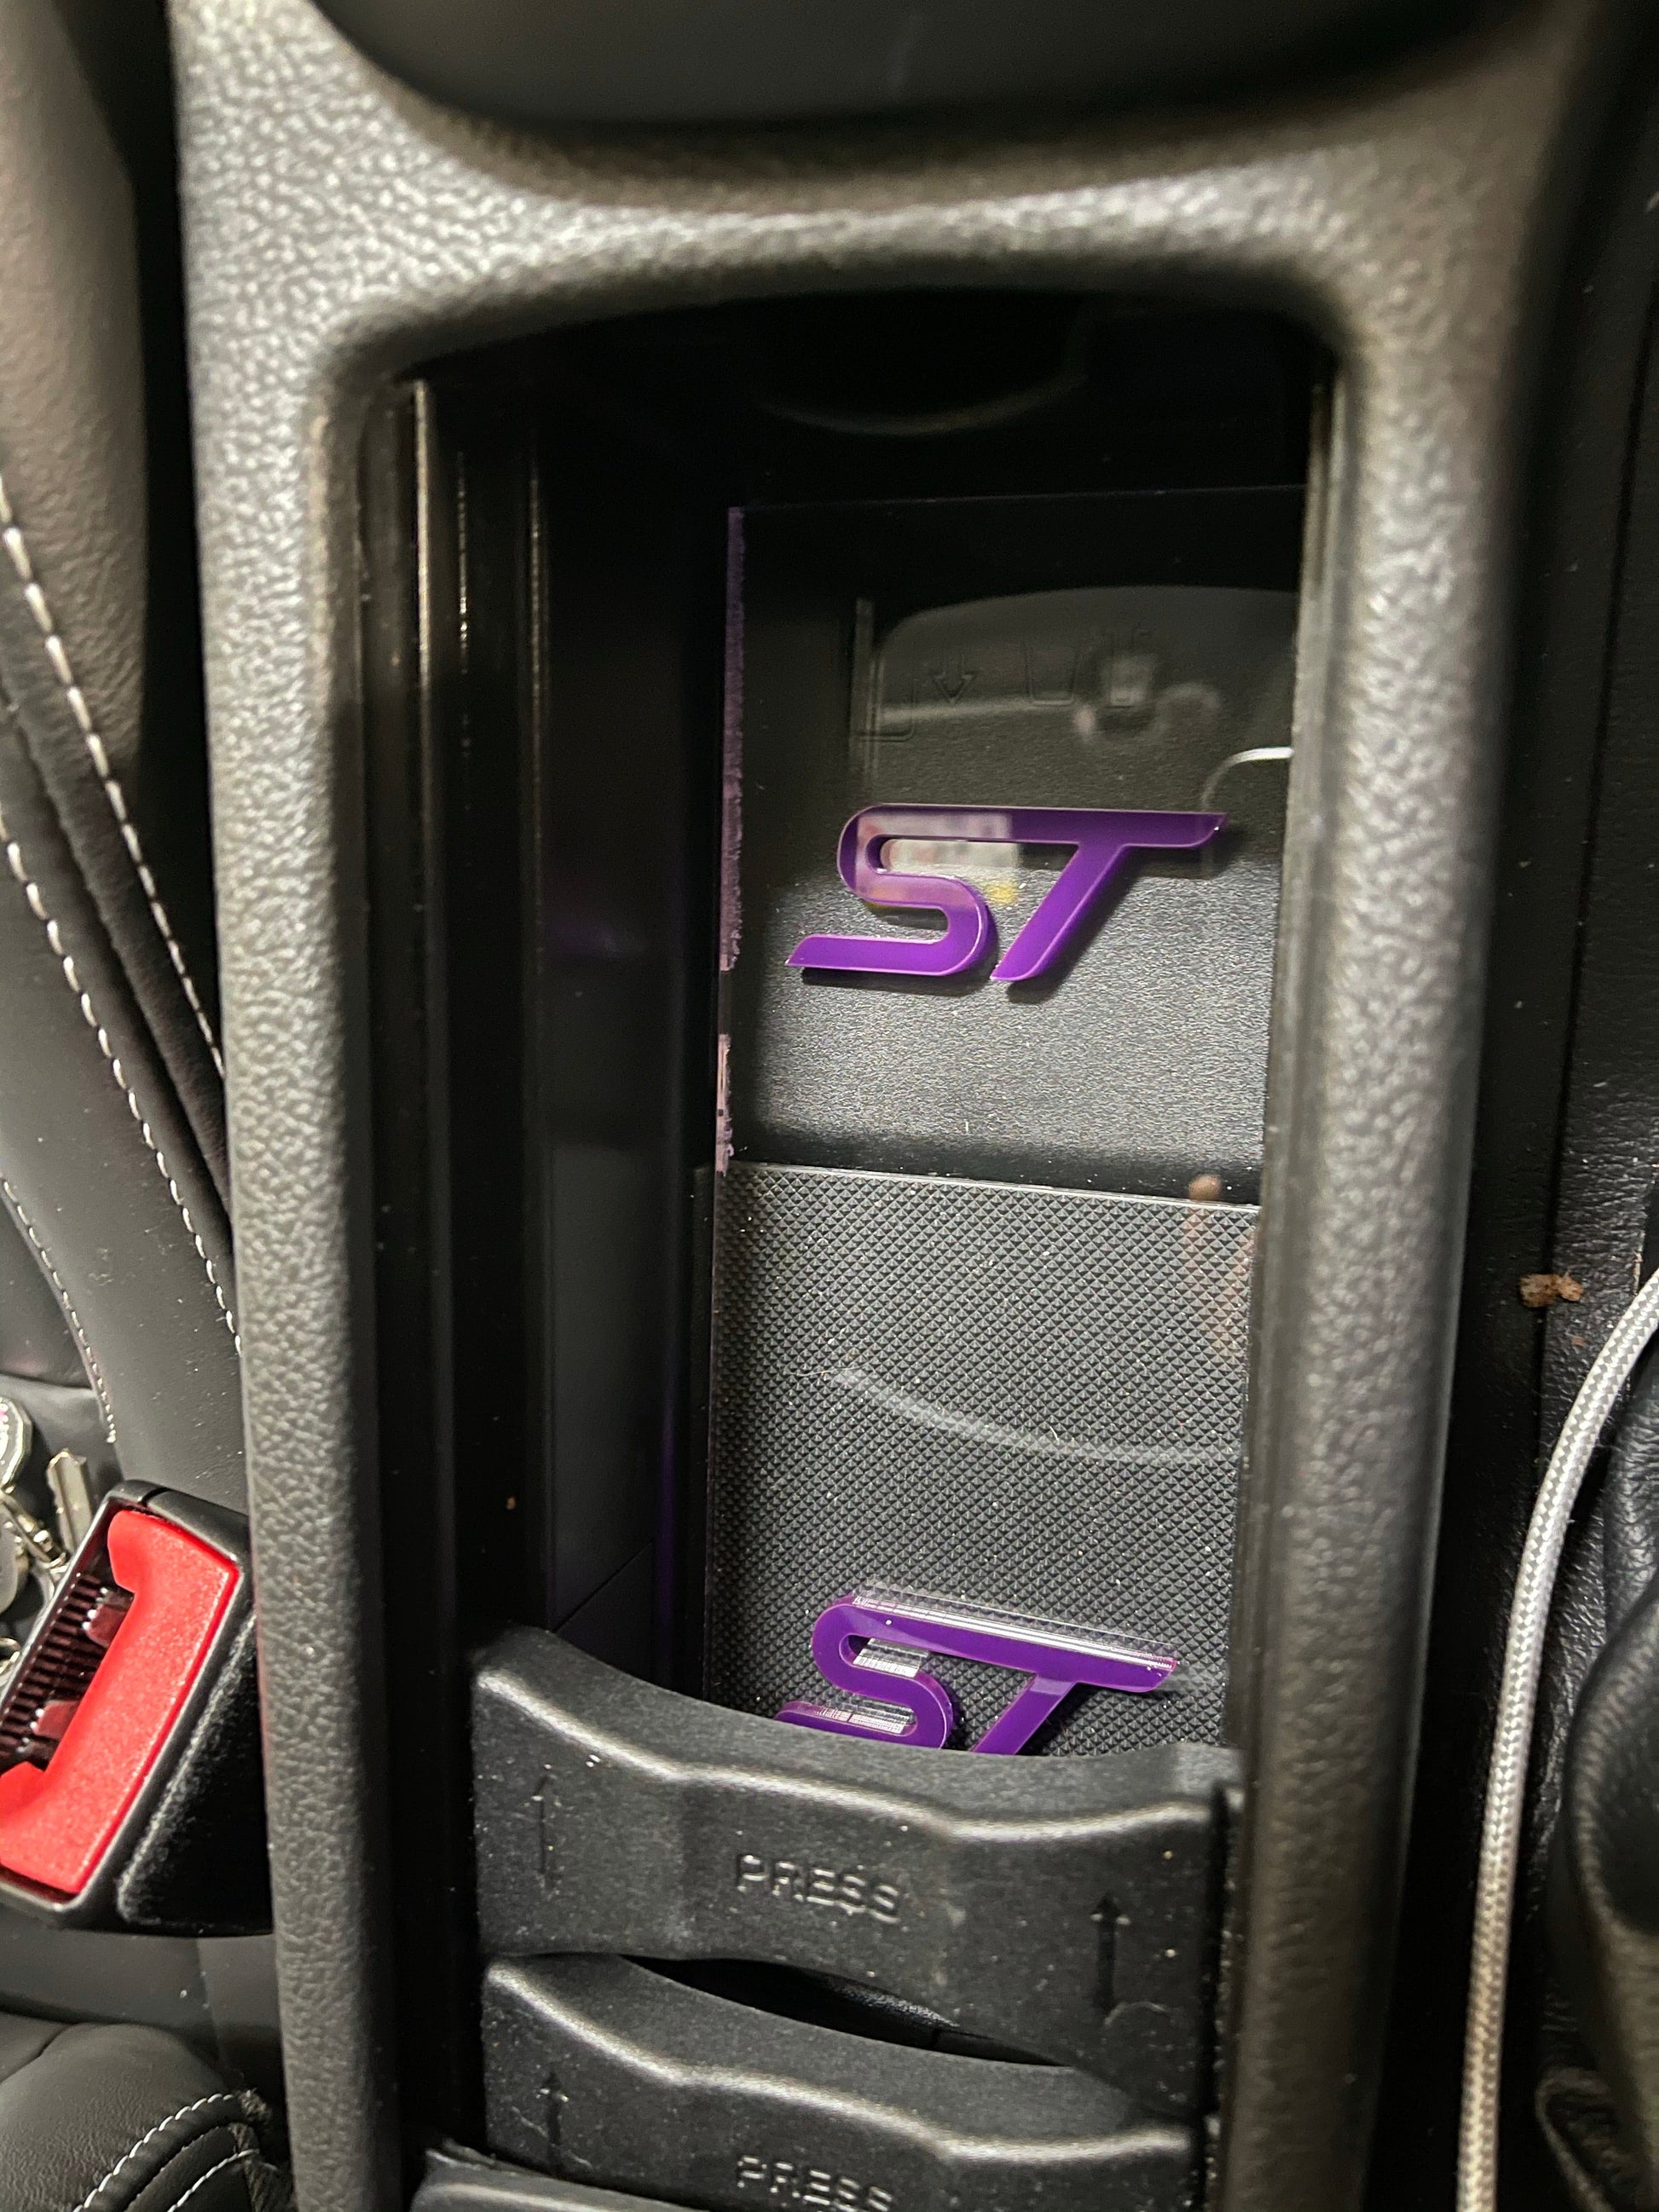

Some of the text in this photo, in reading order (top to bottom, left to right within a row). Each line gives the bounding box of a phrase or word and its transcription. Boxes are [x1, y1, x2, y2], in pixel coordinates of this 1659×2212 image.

[785, 803, 1227, 982] ST
[773, 1595, 1178, 1754] ST
[737, 1854, 901, 1924] PRESS
[737, 2155, 893, 2212] PRESS
